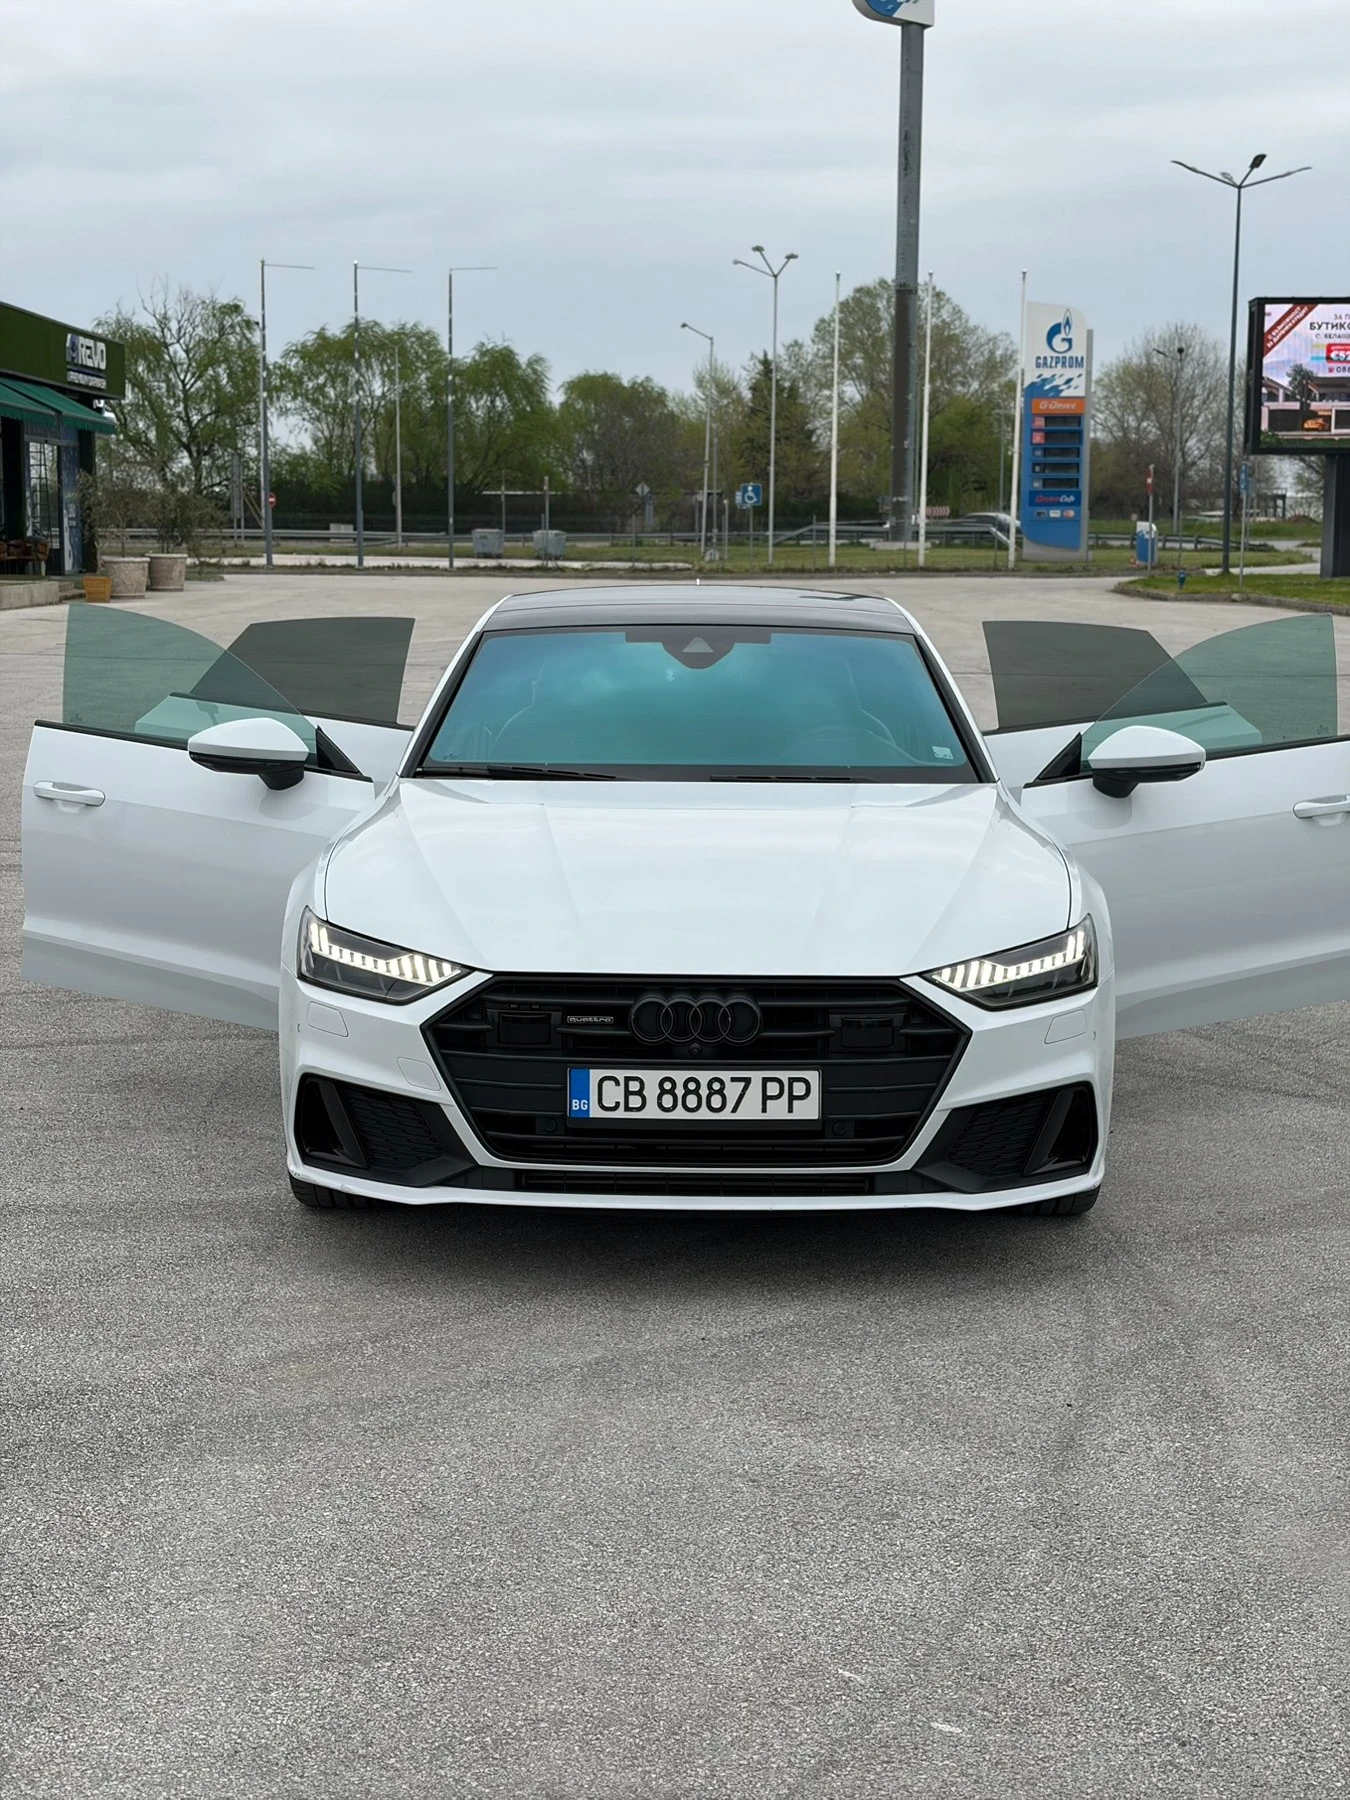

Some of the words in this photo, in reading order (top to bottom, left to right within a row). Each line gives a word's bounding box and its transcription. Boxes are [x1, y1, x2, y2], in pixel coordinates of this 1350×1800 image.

[1035, 356, 1084, 369] GAZPROM
[597, 1076, 647, 1113] CB
[656, 1076, 752, 1113] 8887
[761, 1076, 812, 1113] PP
[572, 1099, 588, 1111] BG
